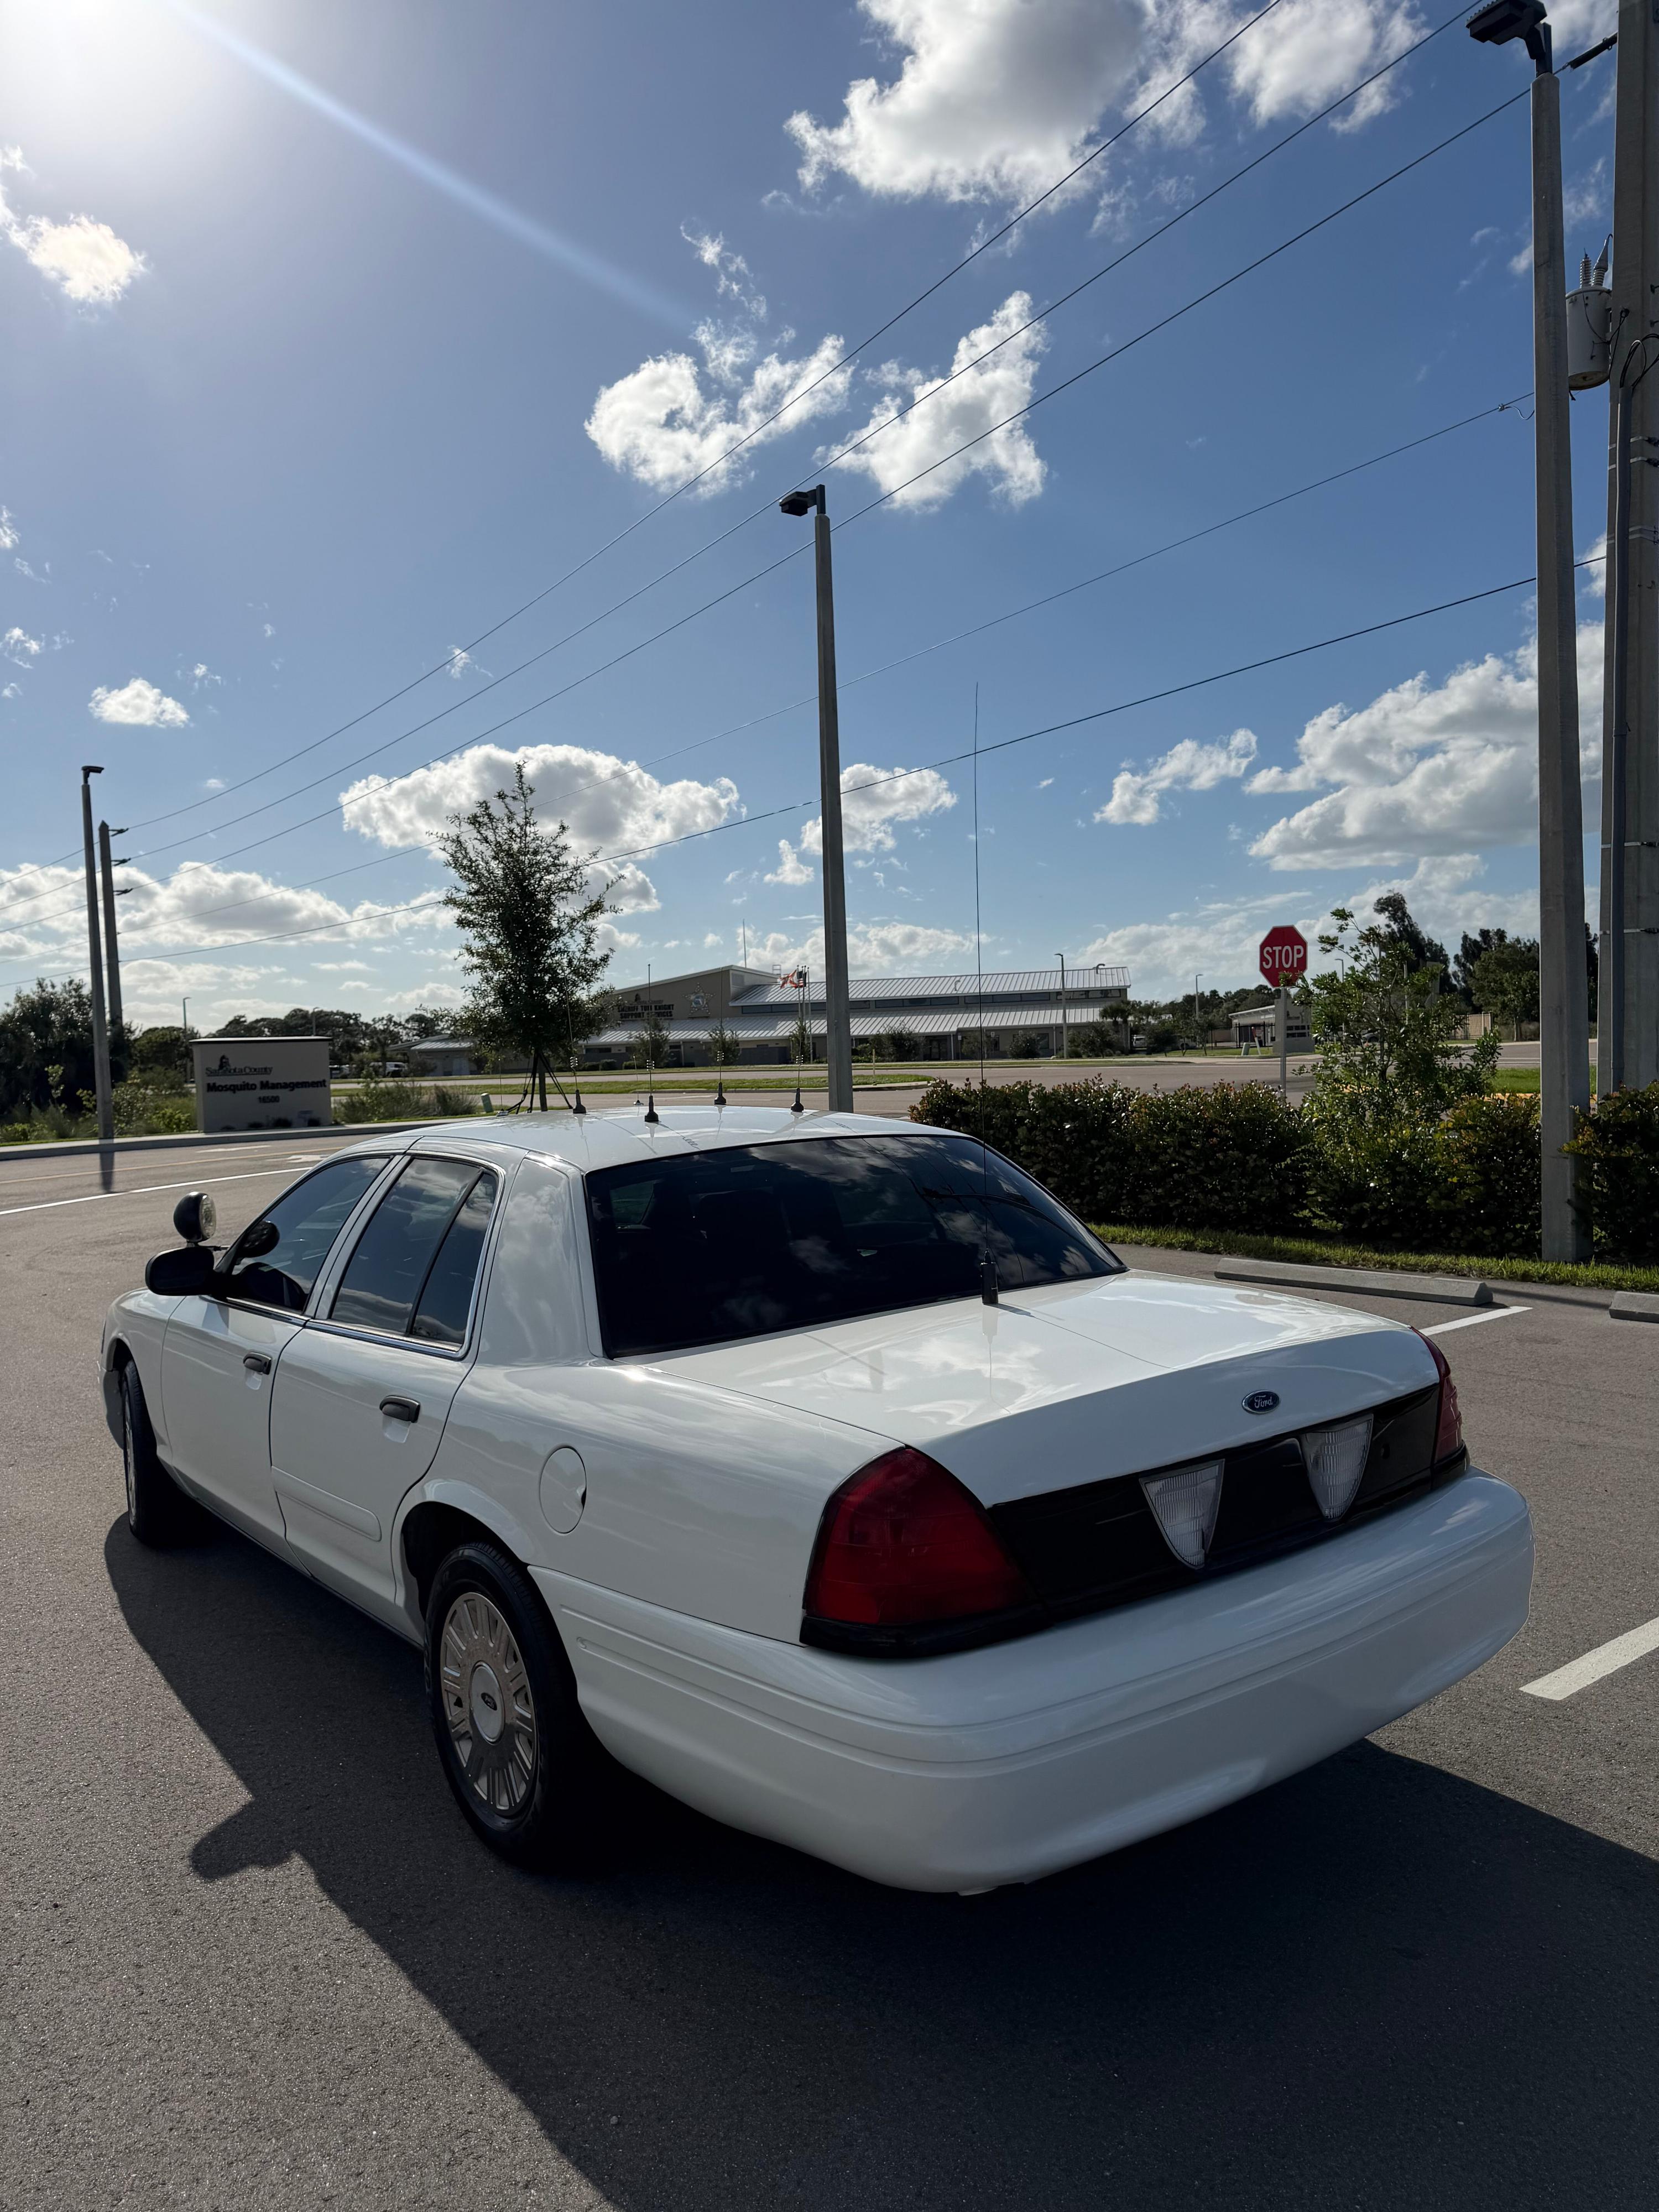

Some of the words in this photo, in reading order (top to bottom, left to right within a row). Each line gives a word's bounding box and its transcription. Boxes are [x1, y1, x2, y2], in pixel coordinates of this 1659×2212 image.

[1262, 945, 1304, 969] STOP
[207, 1081, 257, 1094] Mosquito
[260, 1079, 326, 1091] Management
[1254, 1395, 1273, 1408] Ford
